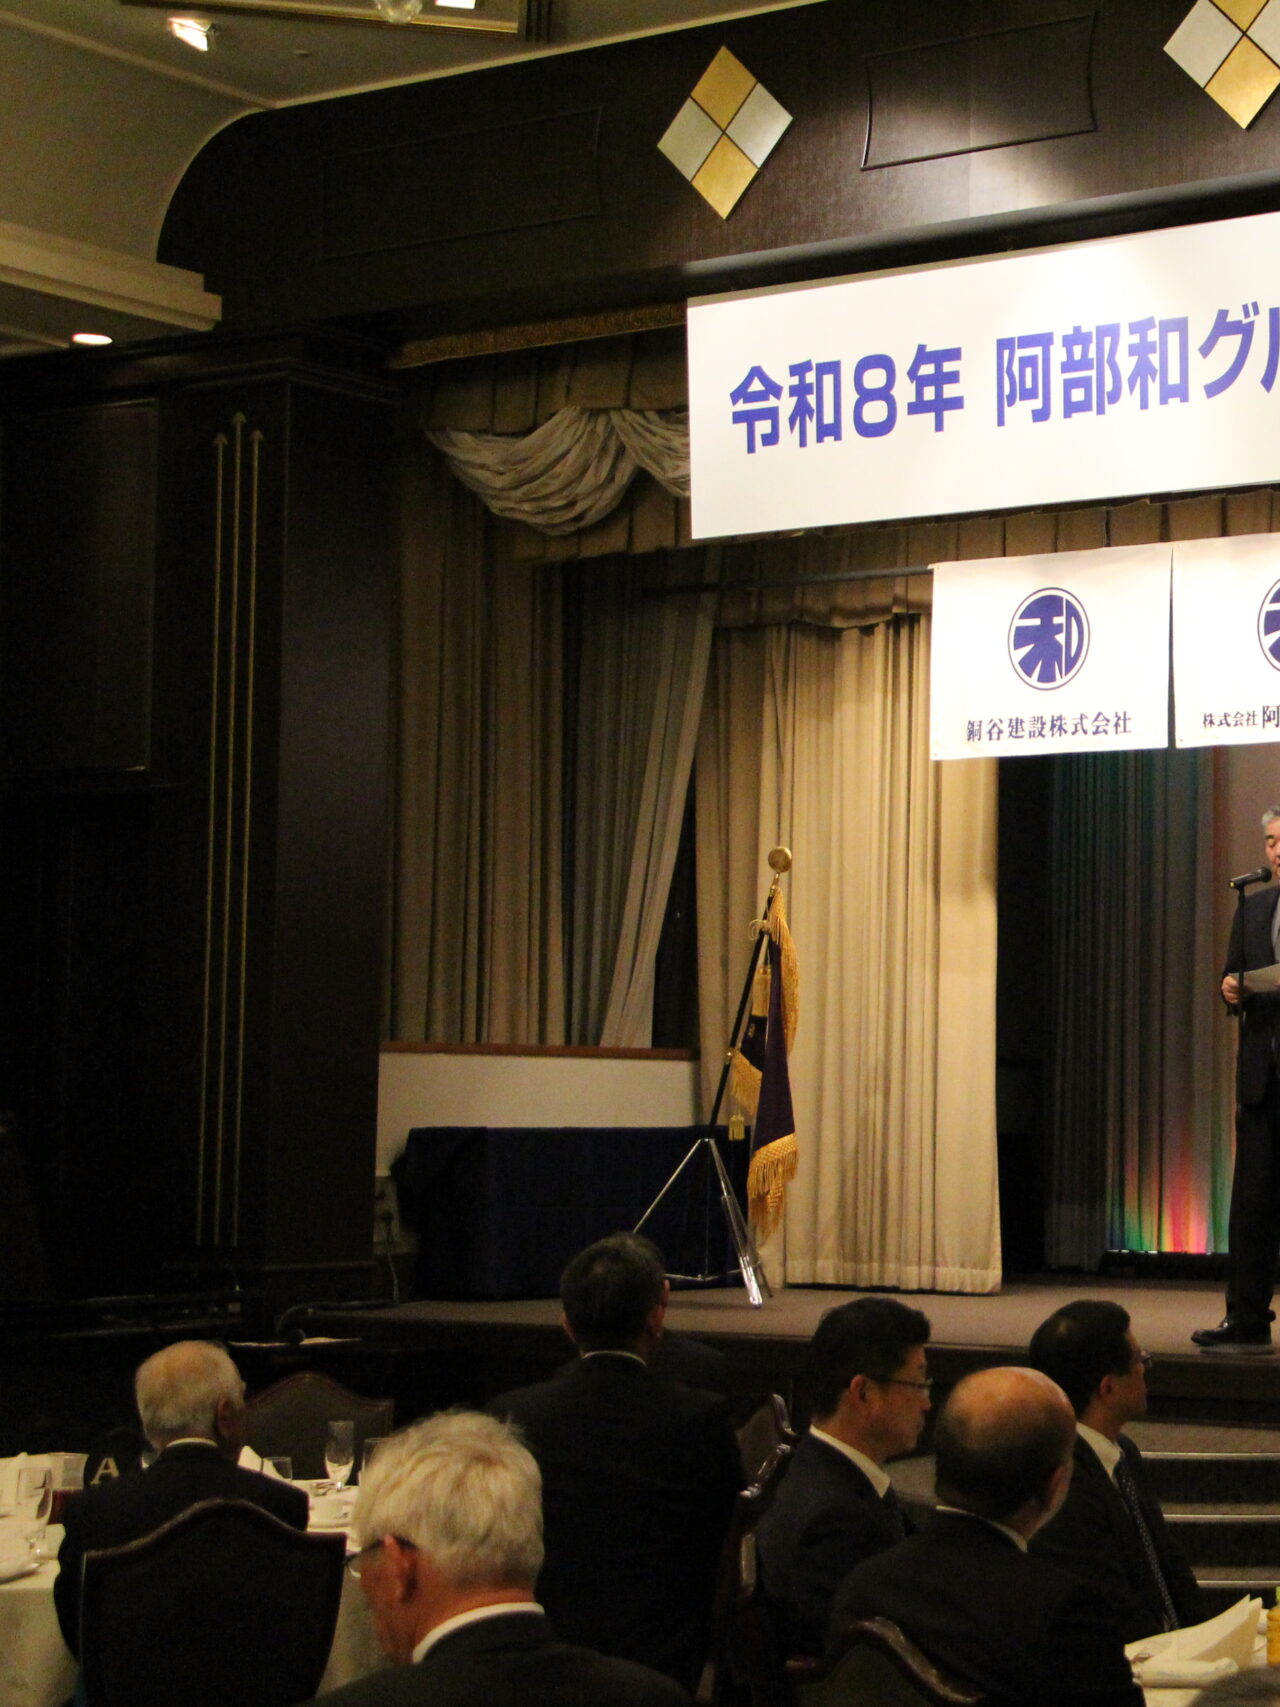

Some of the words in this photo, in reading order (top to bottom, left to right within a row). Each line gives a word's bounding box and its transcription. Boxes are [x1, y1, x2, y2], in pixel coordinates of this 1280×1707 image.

[730, 344, 964, 454] 令和8年
[966, 711, 1132, 742] 銅谷建設株式会社
